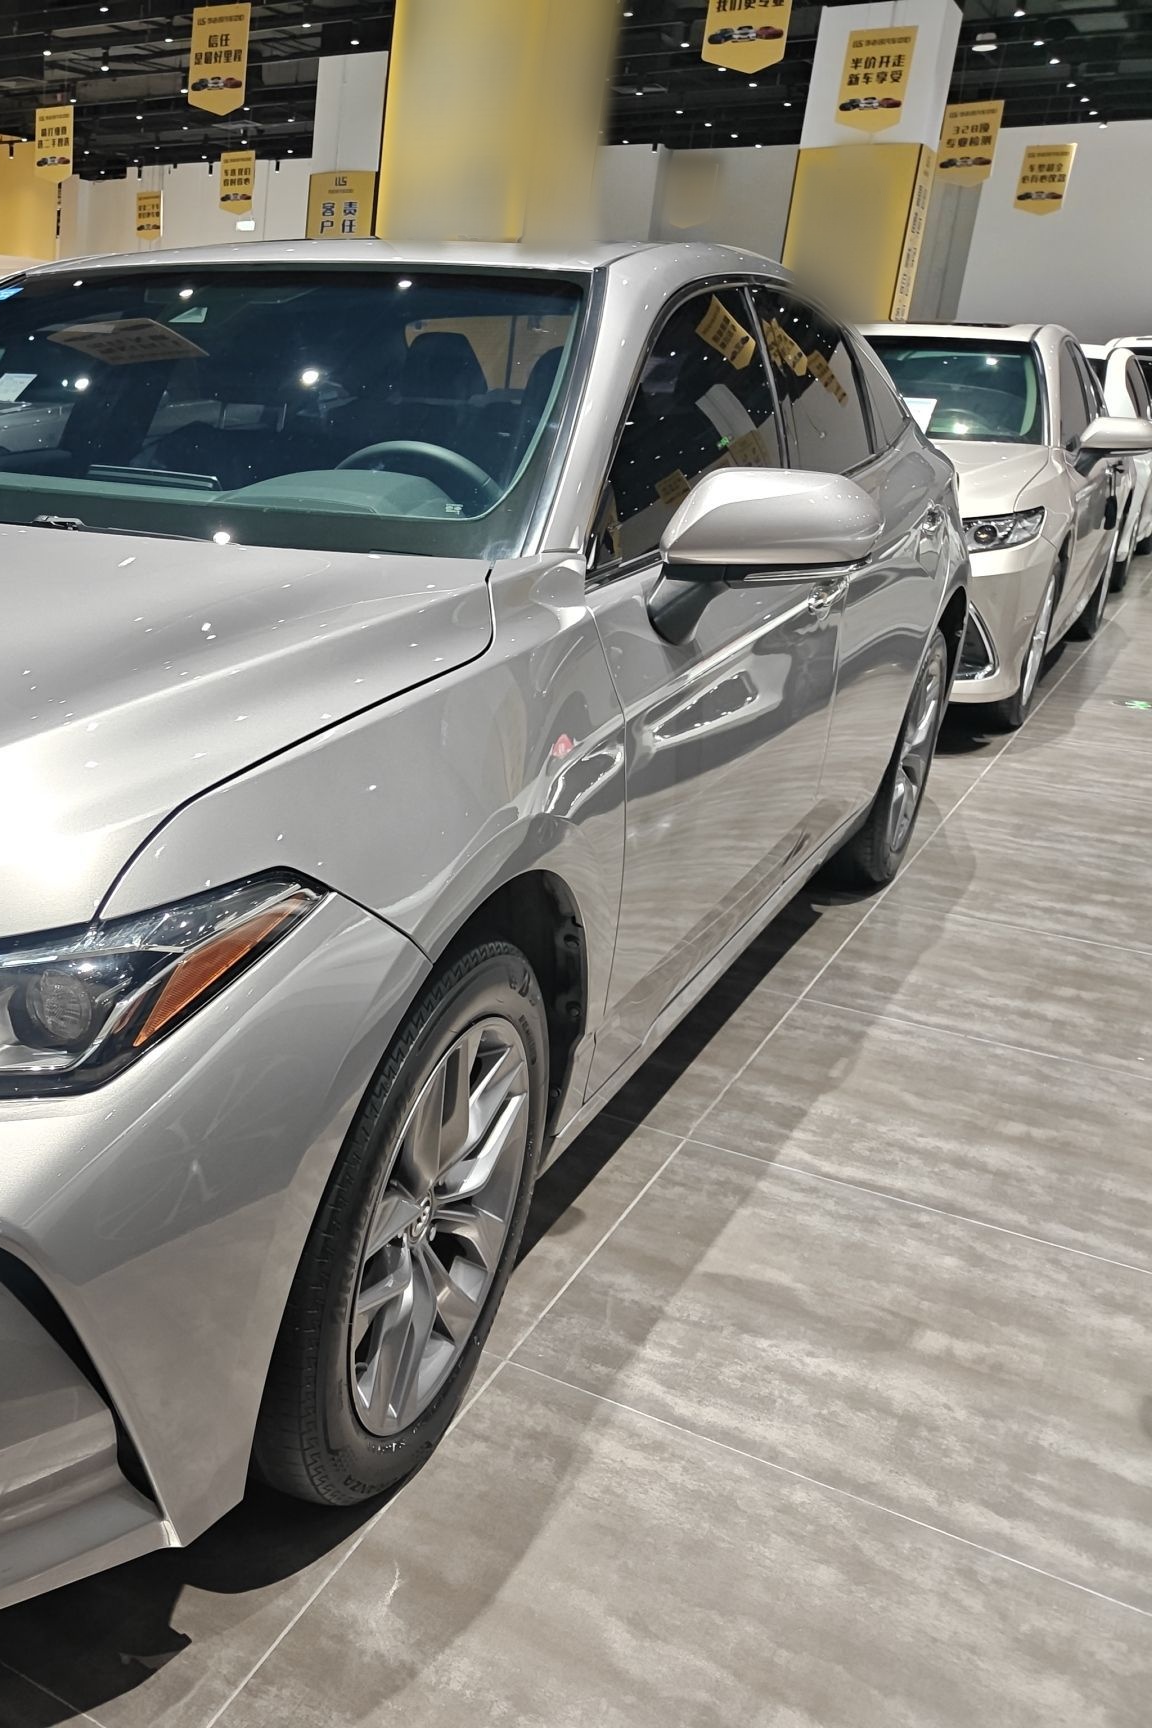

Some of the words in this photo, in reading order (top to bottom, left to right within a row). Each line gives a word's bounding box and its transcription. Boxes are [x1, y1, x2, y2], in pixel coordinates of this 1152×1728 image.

[208, 33, 230, 48] 信任
[850, 54, 906, 70] 半价开走
[847, 70, 903, 86] 新车享受
